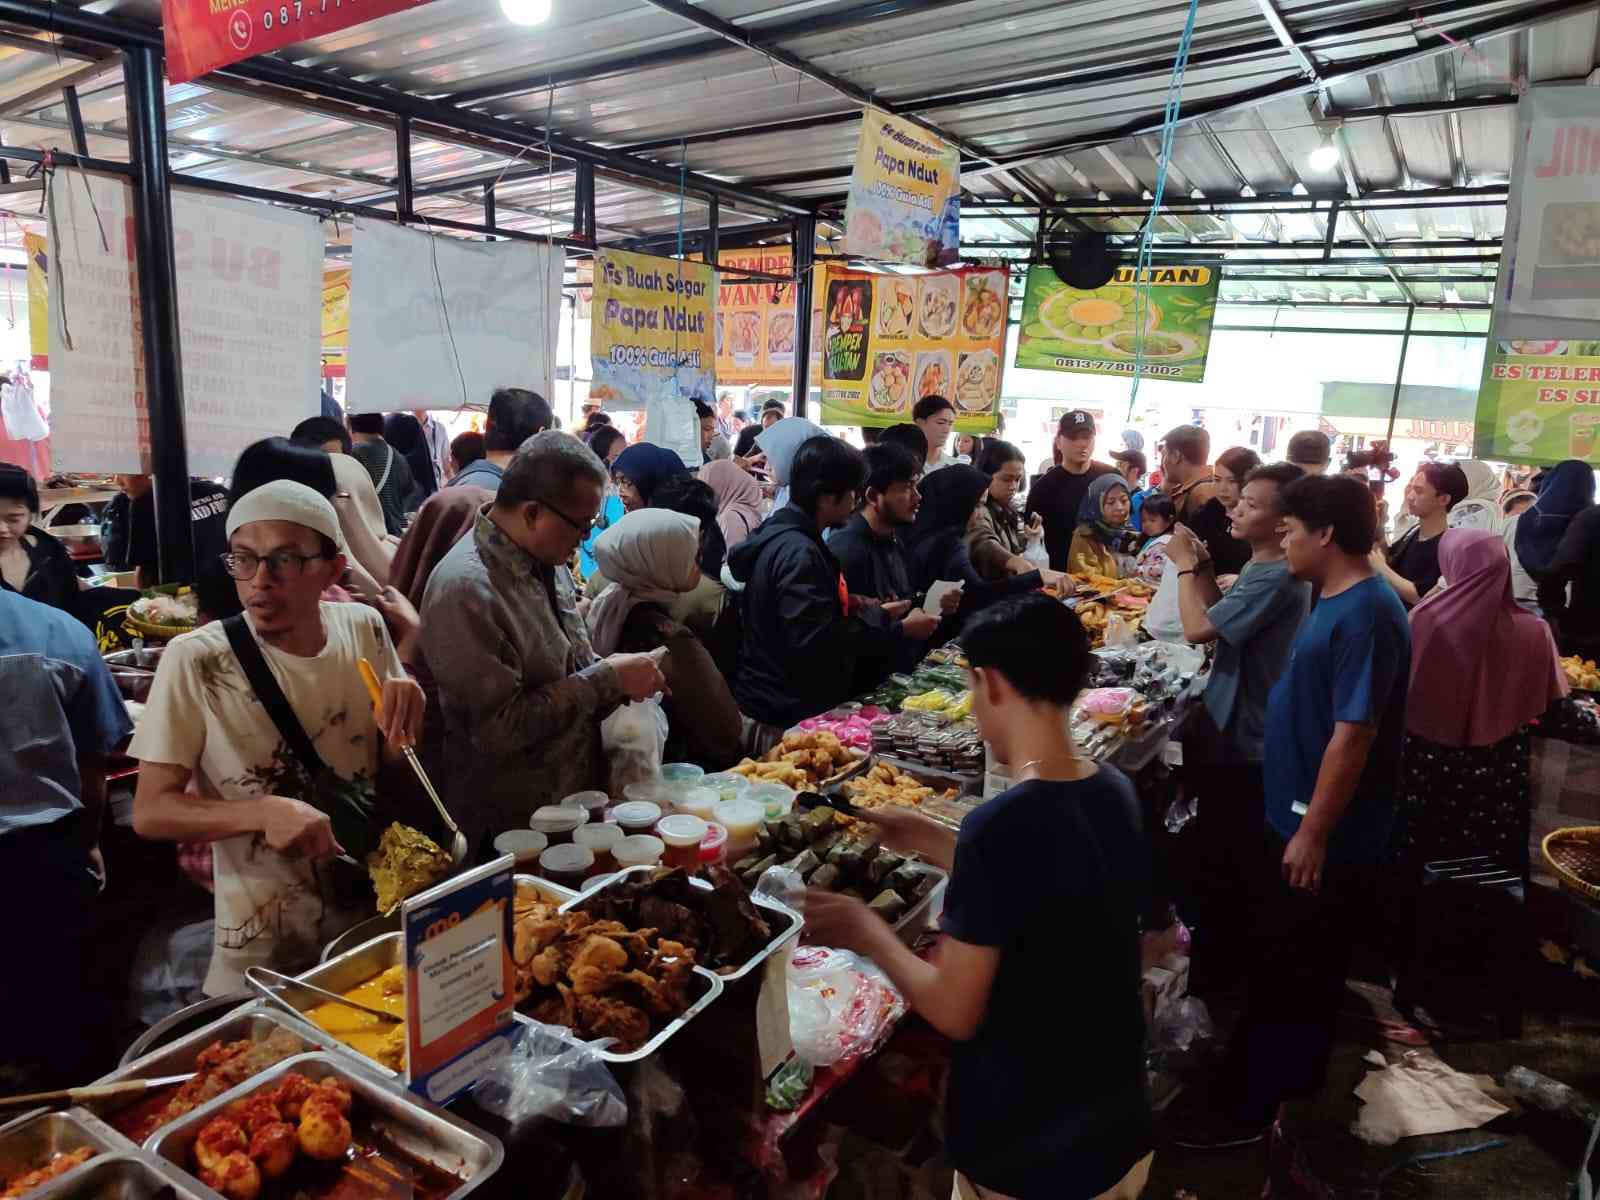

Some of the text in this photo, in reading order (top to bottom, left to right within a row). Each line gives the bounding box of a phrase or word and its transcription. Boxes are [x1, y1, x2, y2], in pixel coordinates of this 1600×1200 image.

[874, 146, 939, 185] Papa Ndut
[602, 262, 706, 299] Es Buah Segar
[1114, 268, 1200, 283] ULTAN
[605, 298, 705, 334] Papa Ndut
[609, 344, 647, 367] 100%
[1493, 366, 1521, 379] ES
[1539, 389, 1568, 402] ES
